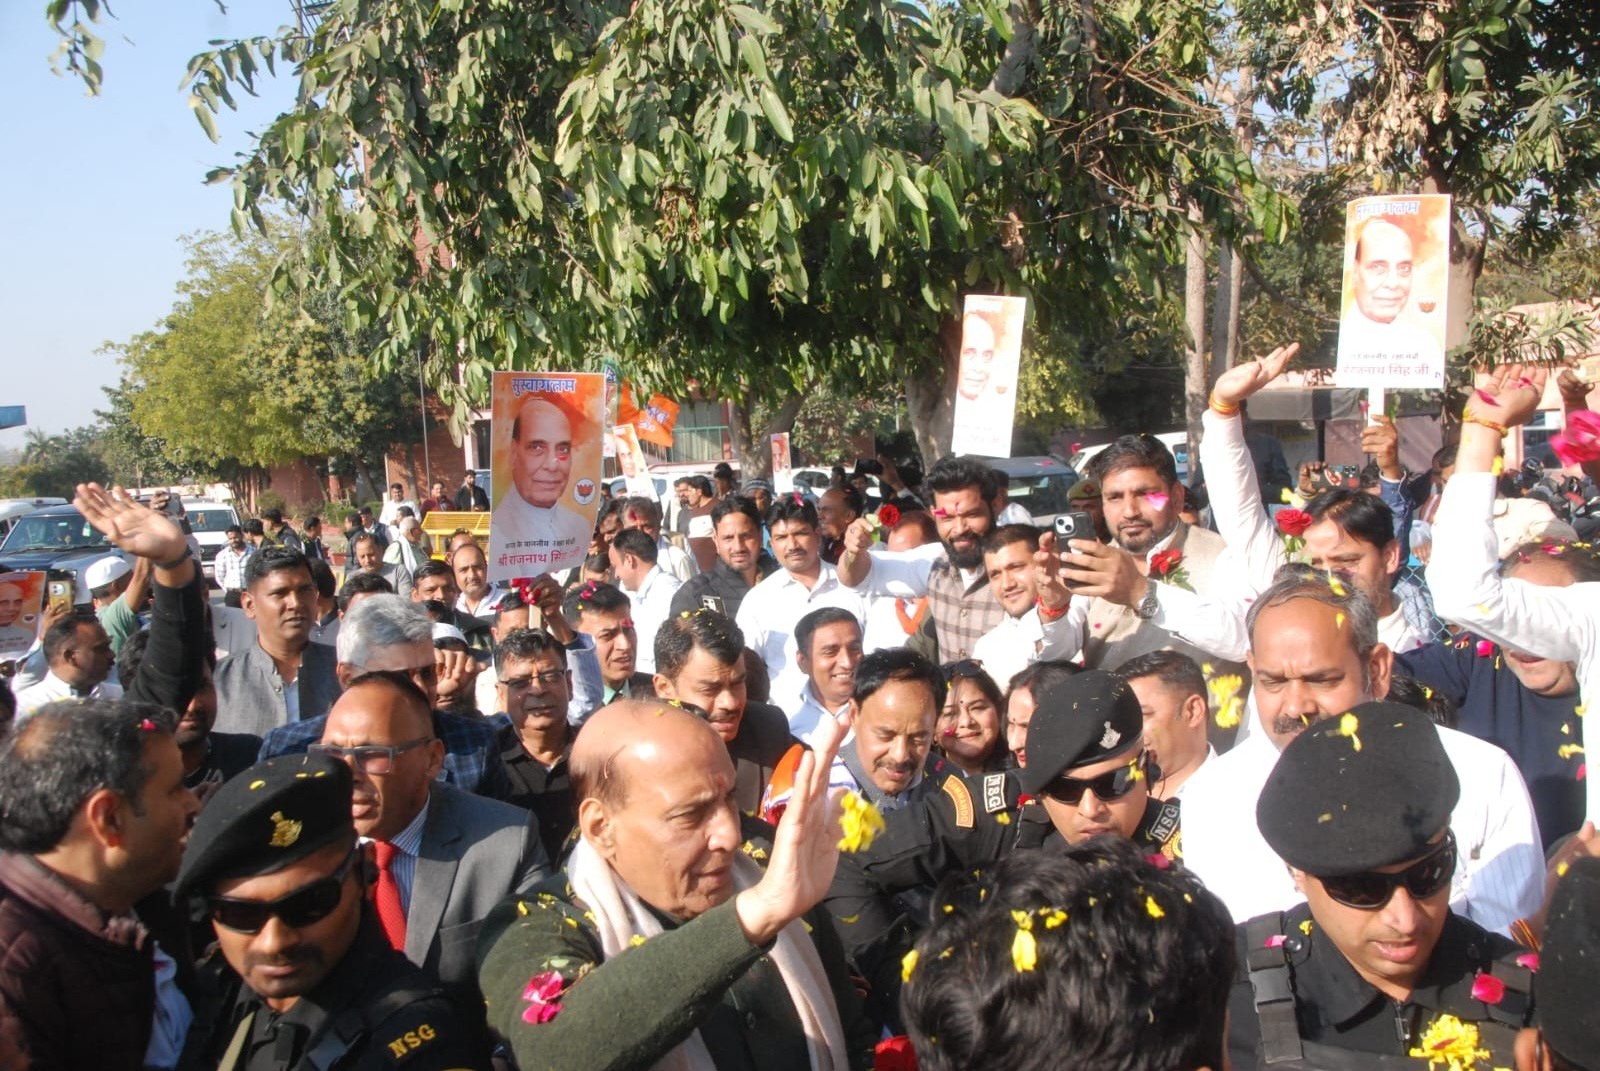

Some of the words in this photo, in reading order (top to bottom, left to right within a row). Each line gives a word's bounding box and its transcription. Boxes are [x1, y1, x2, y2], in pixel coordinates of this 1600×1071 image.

[509, 552, 547, 566] राजनाथ
[988, 775, 1001, 808] NSG
[1154, 807, 1179, 838] NSG
[388, 1023, 436, 1059] NSG
